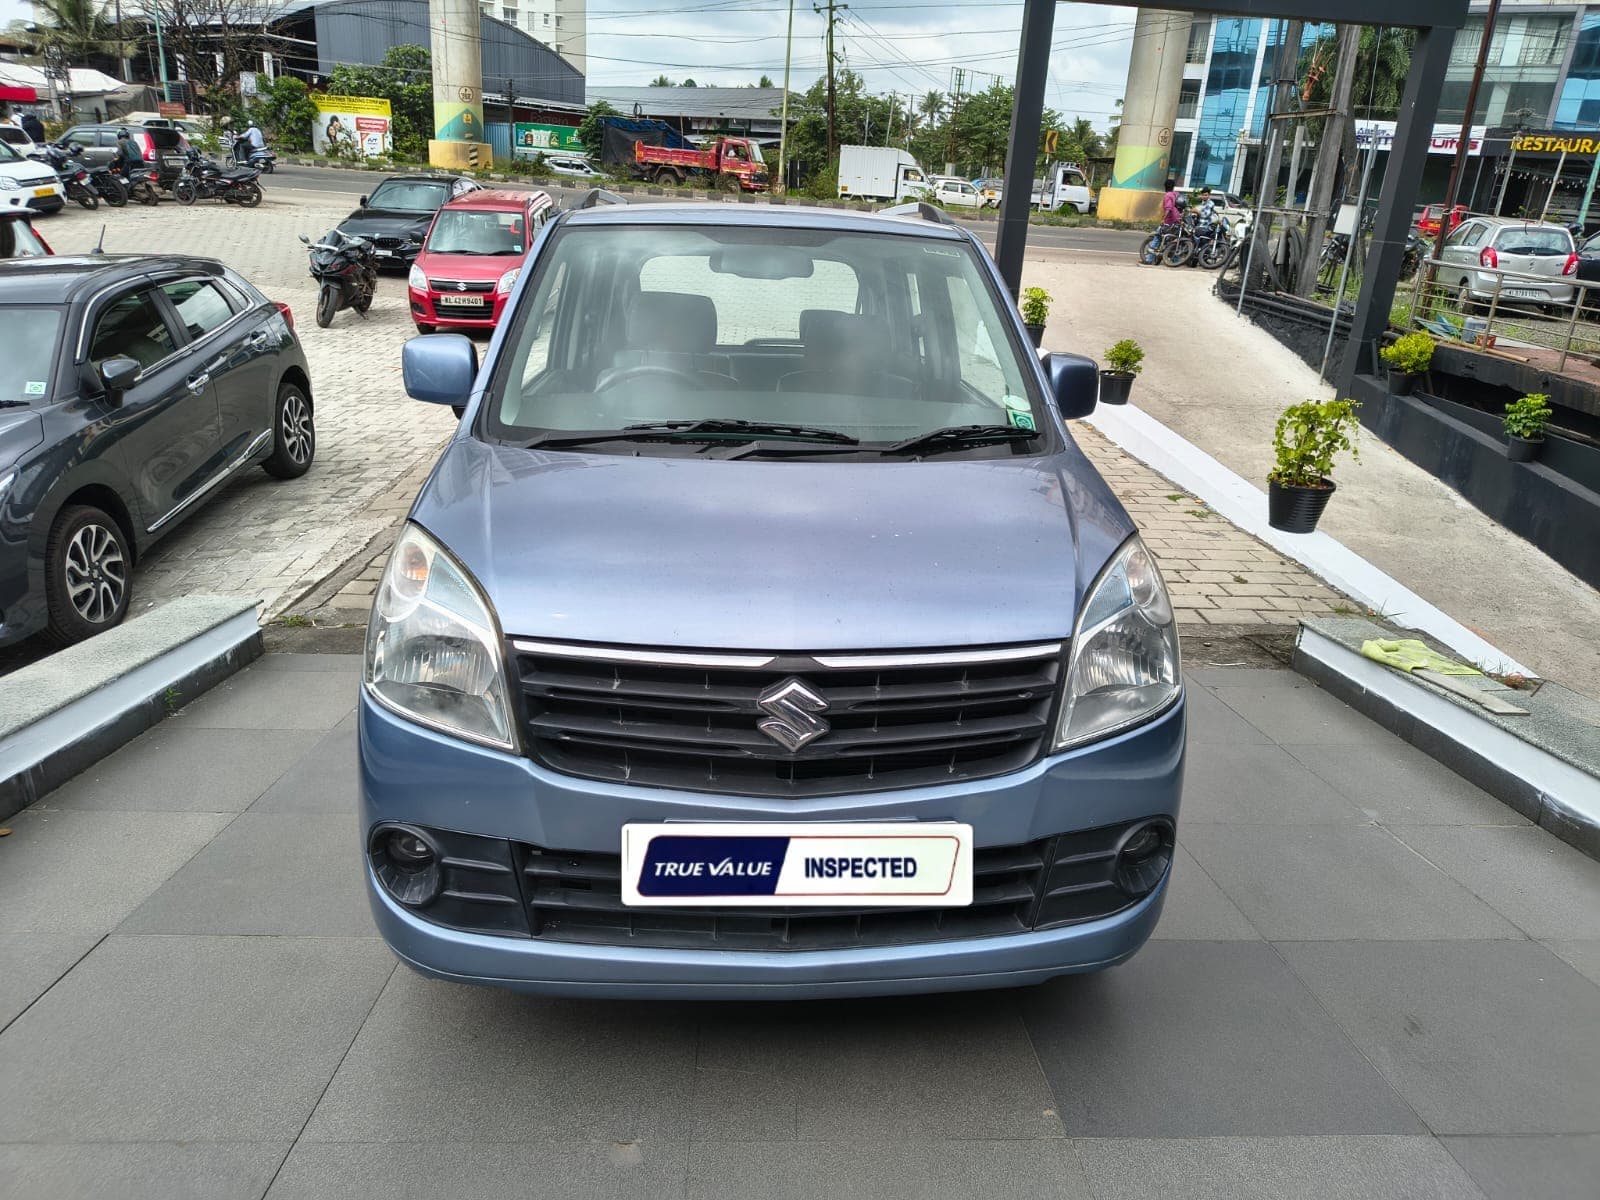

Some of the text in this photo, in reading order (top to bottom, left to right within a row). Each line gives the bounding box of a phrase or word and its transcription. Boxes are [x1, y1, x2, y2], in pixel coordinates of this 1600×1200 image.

[654, 857, 918, 879] TRUE VALUE INSPECTED
